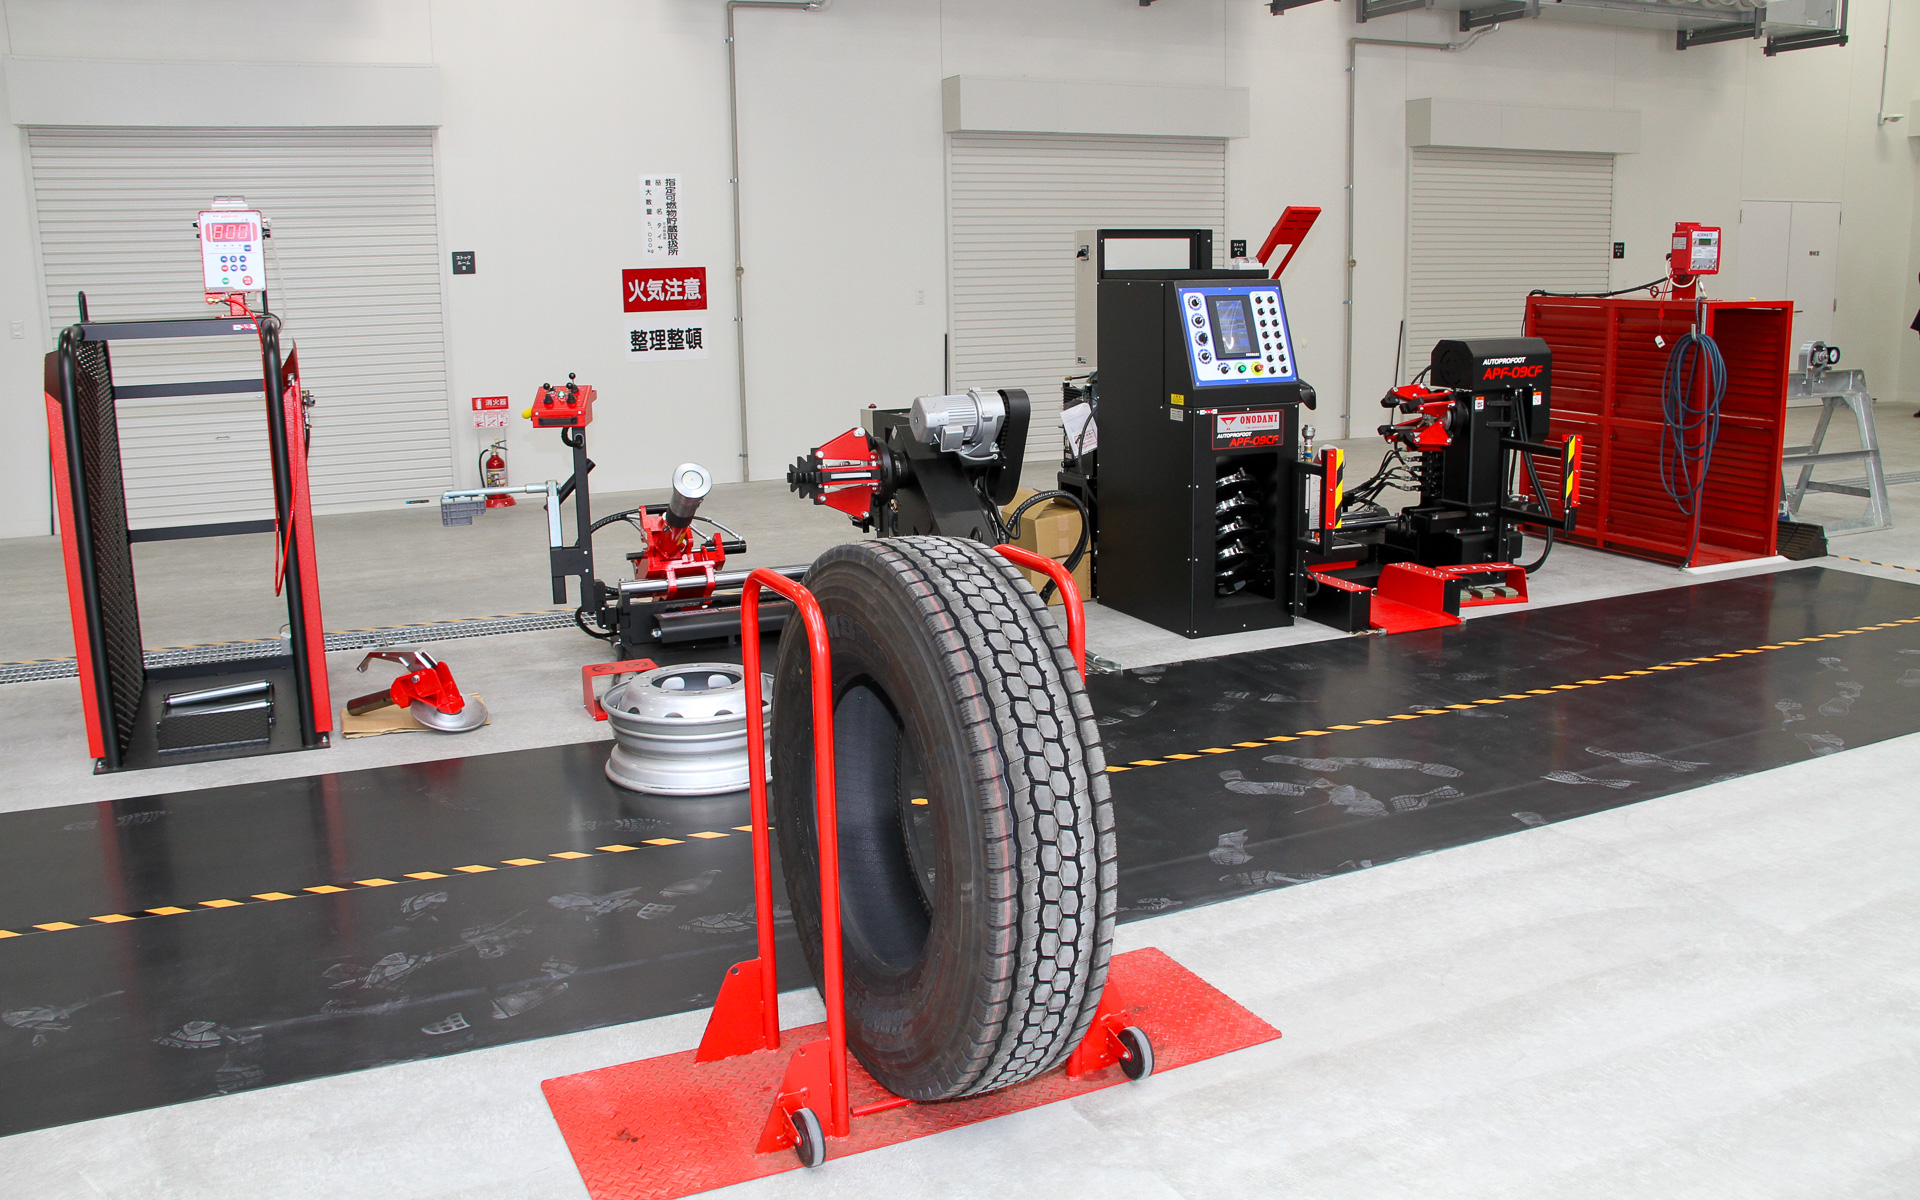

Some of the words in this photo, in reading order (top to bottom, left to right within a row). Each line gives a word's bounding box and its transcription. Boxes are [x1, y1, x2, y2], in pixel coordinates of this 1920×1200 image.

[665, 178, 679, 256] 指定可燃物貯蔵取扱所
[212, 224, 248, 240] 800
[628, 277, 702, 303] 火気注意
[630, 327, 703, 352] 整理整頓
[1482, 356, 1527, 365] AUTOPROFOOT
[1482, 365, 1543, 380] APF-09CF
[485, 398, 507, 407] 消火器
[1240, 414, 1278, 425] ONODANI
[1217, 431, 1252, 439] AUTOPROFOOT
[1229, 435, 1279, 447] APF-09CF
